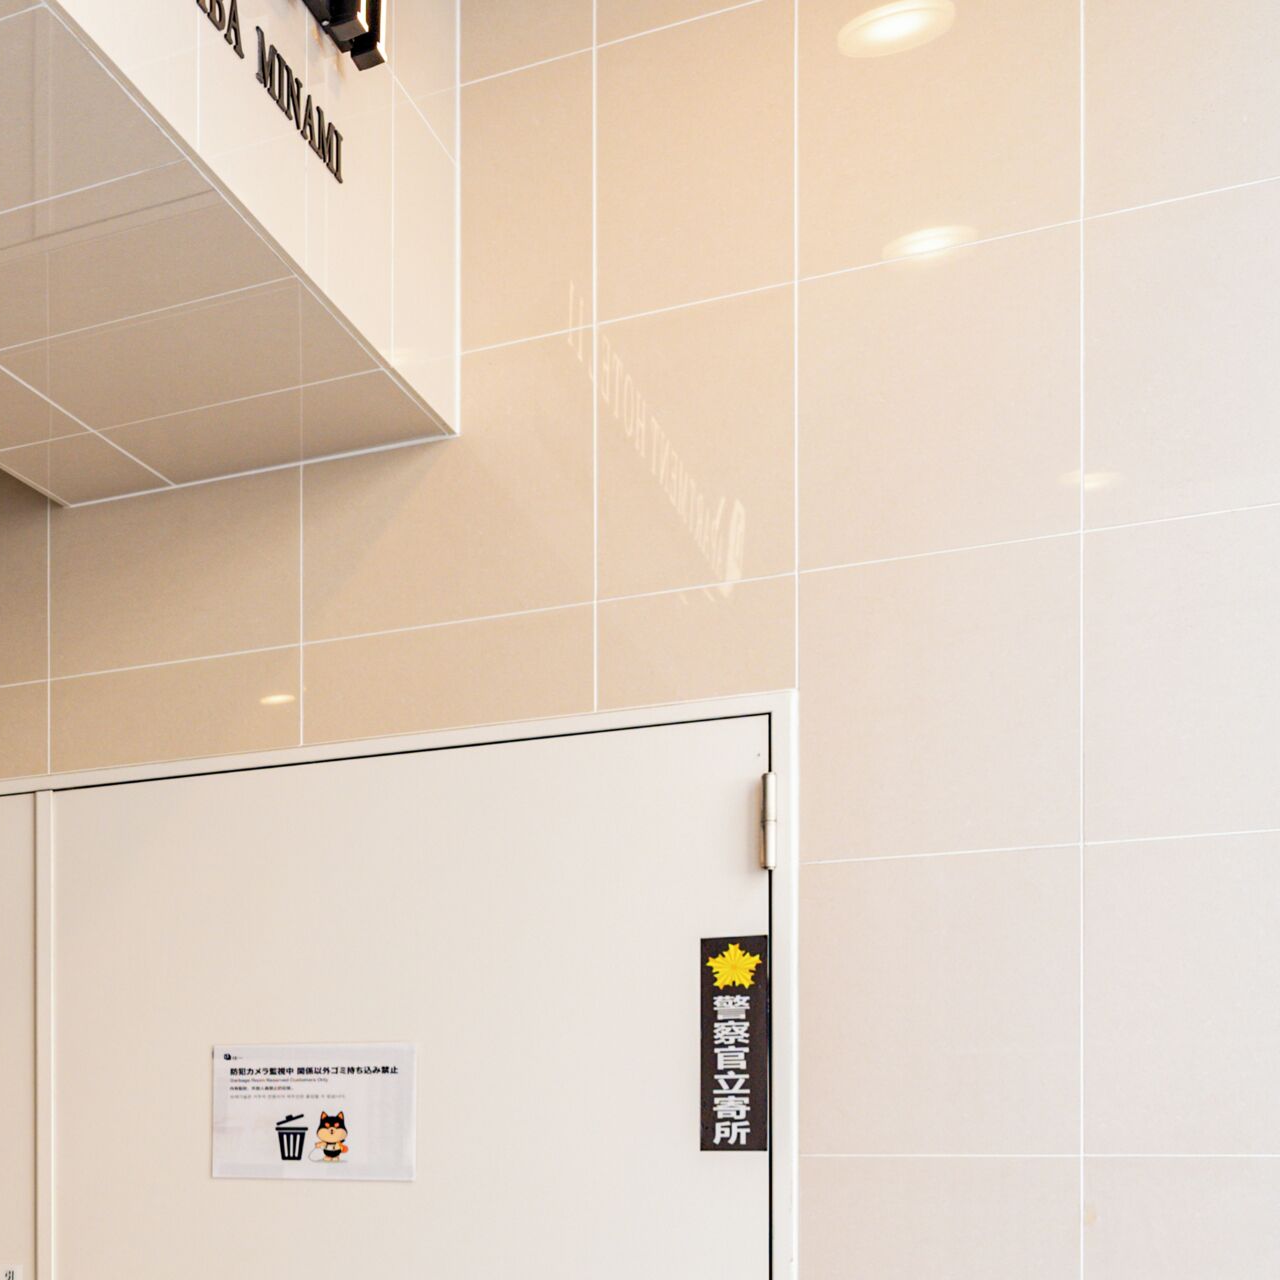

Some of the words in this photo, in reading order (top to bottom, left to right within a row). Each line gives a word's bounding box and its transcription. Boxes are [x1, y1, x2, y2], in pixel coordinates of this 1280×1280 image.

[255, 25, 344, 184] MINAMI
[712, 994, 751, 1145] 警察官立寄所
